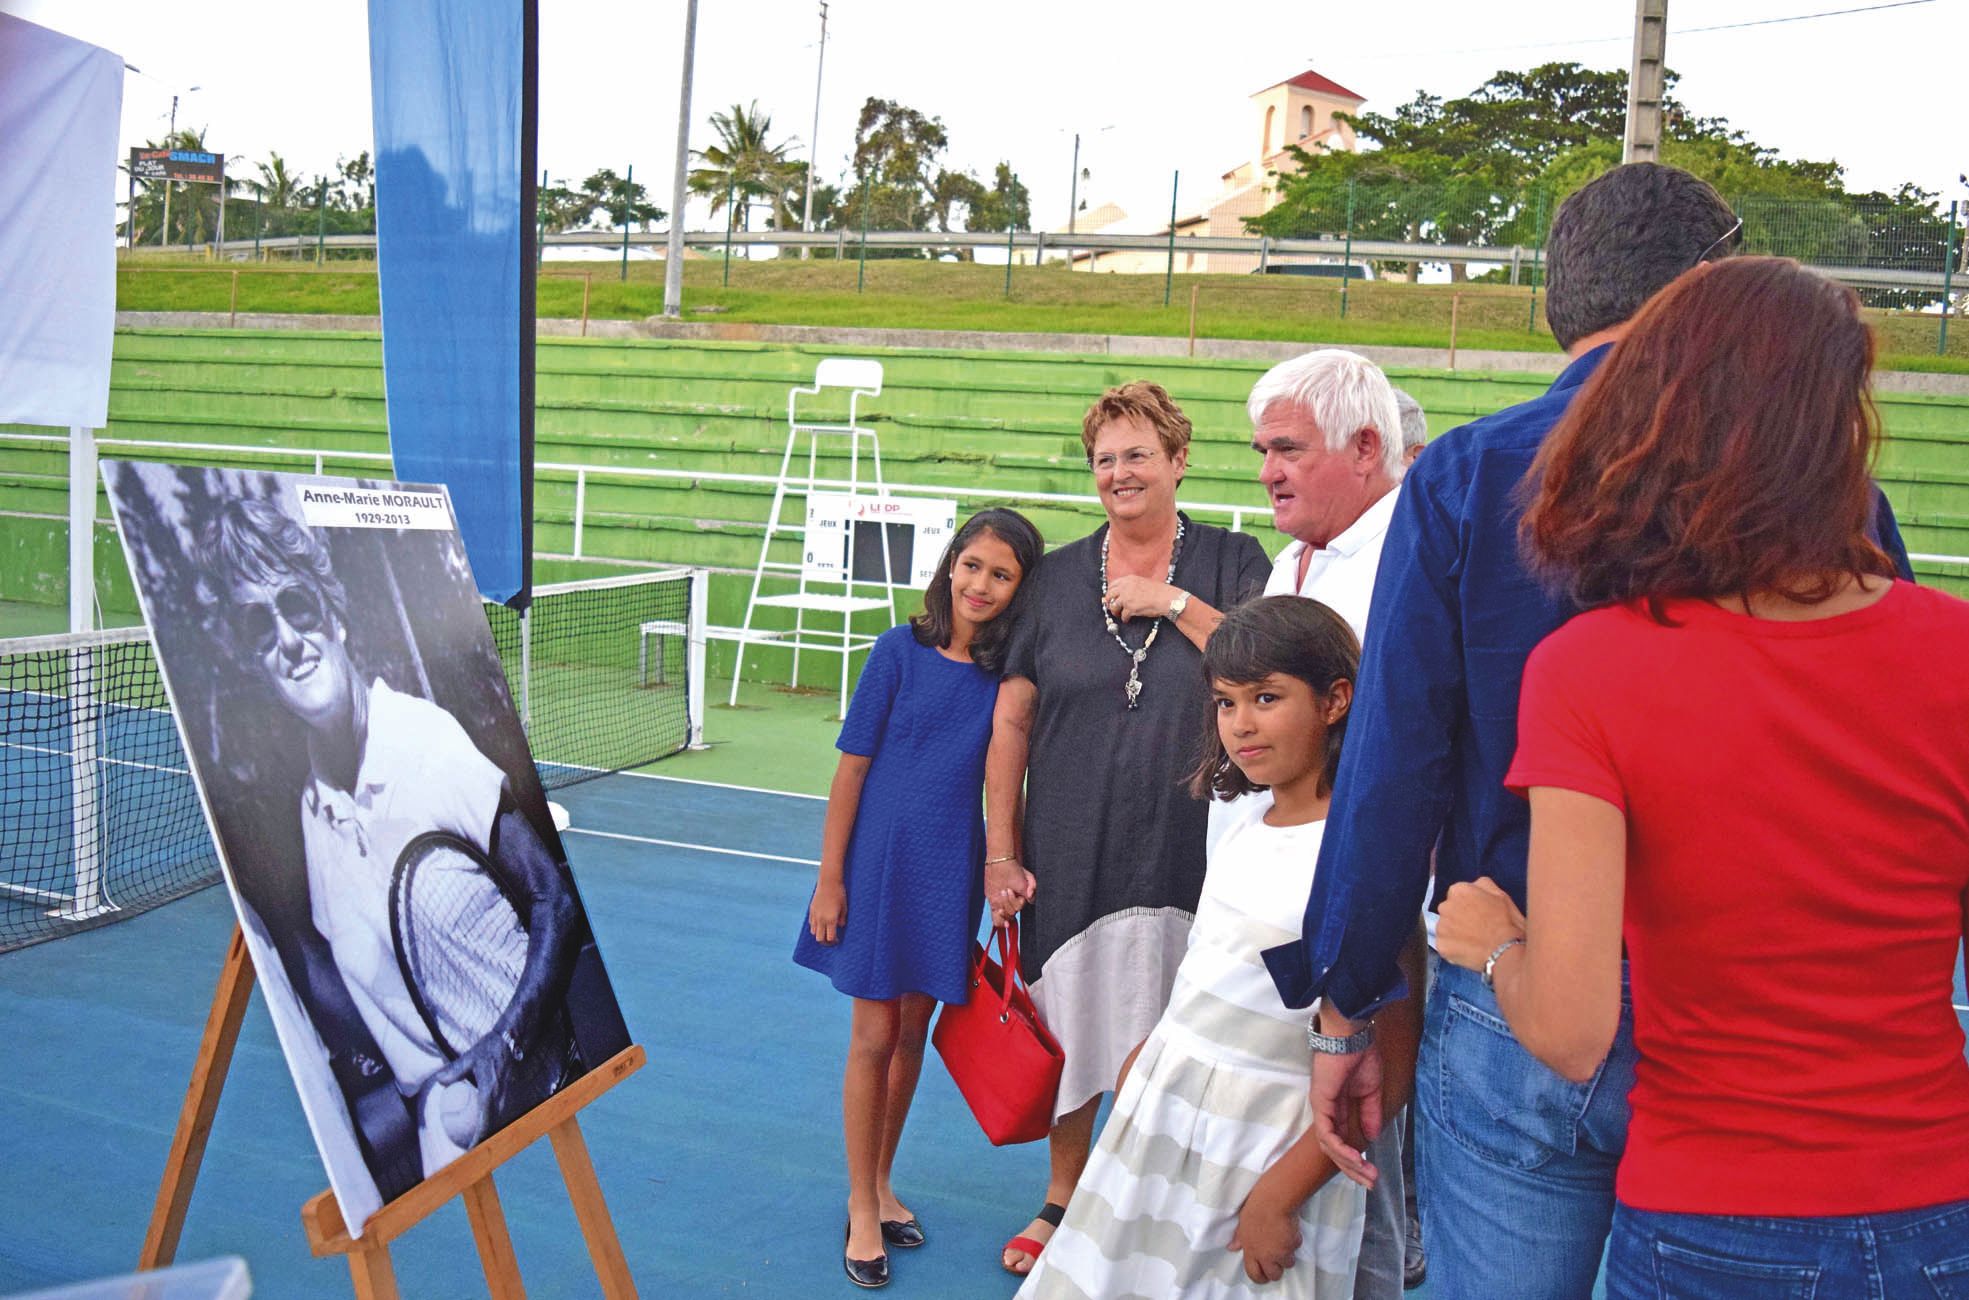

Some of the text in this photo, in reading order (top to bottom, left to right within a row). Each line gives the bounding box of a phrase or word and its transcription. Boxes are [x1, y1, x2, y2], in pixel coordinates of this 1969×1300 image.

[169, 151, 216, 164] SMACH
[304, 489, 443, 509] Anne-Marie MORAULT
[355, 512, 411, 525] 1929-2013
[819, 519, 837, 528] JEUX
[922, 527, 941, 535] JEUX
